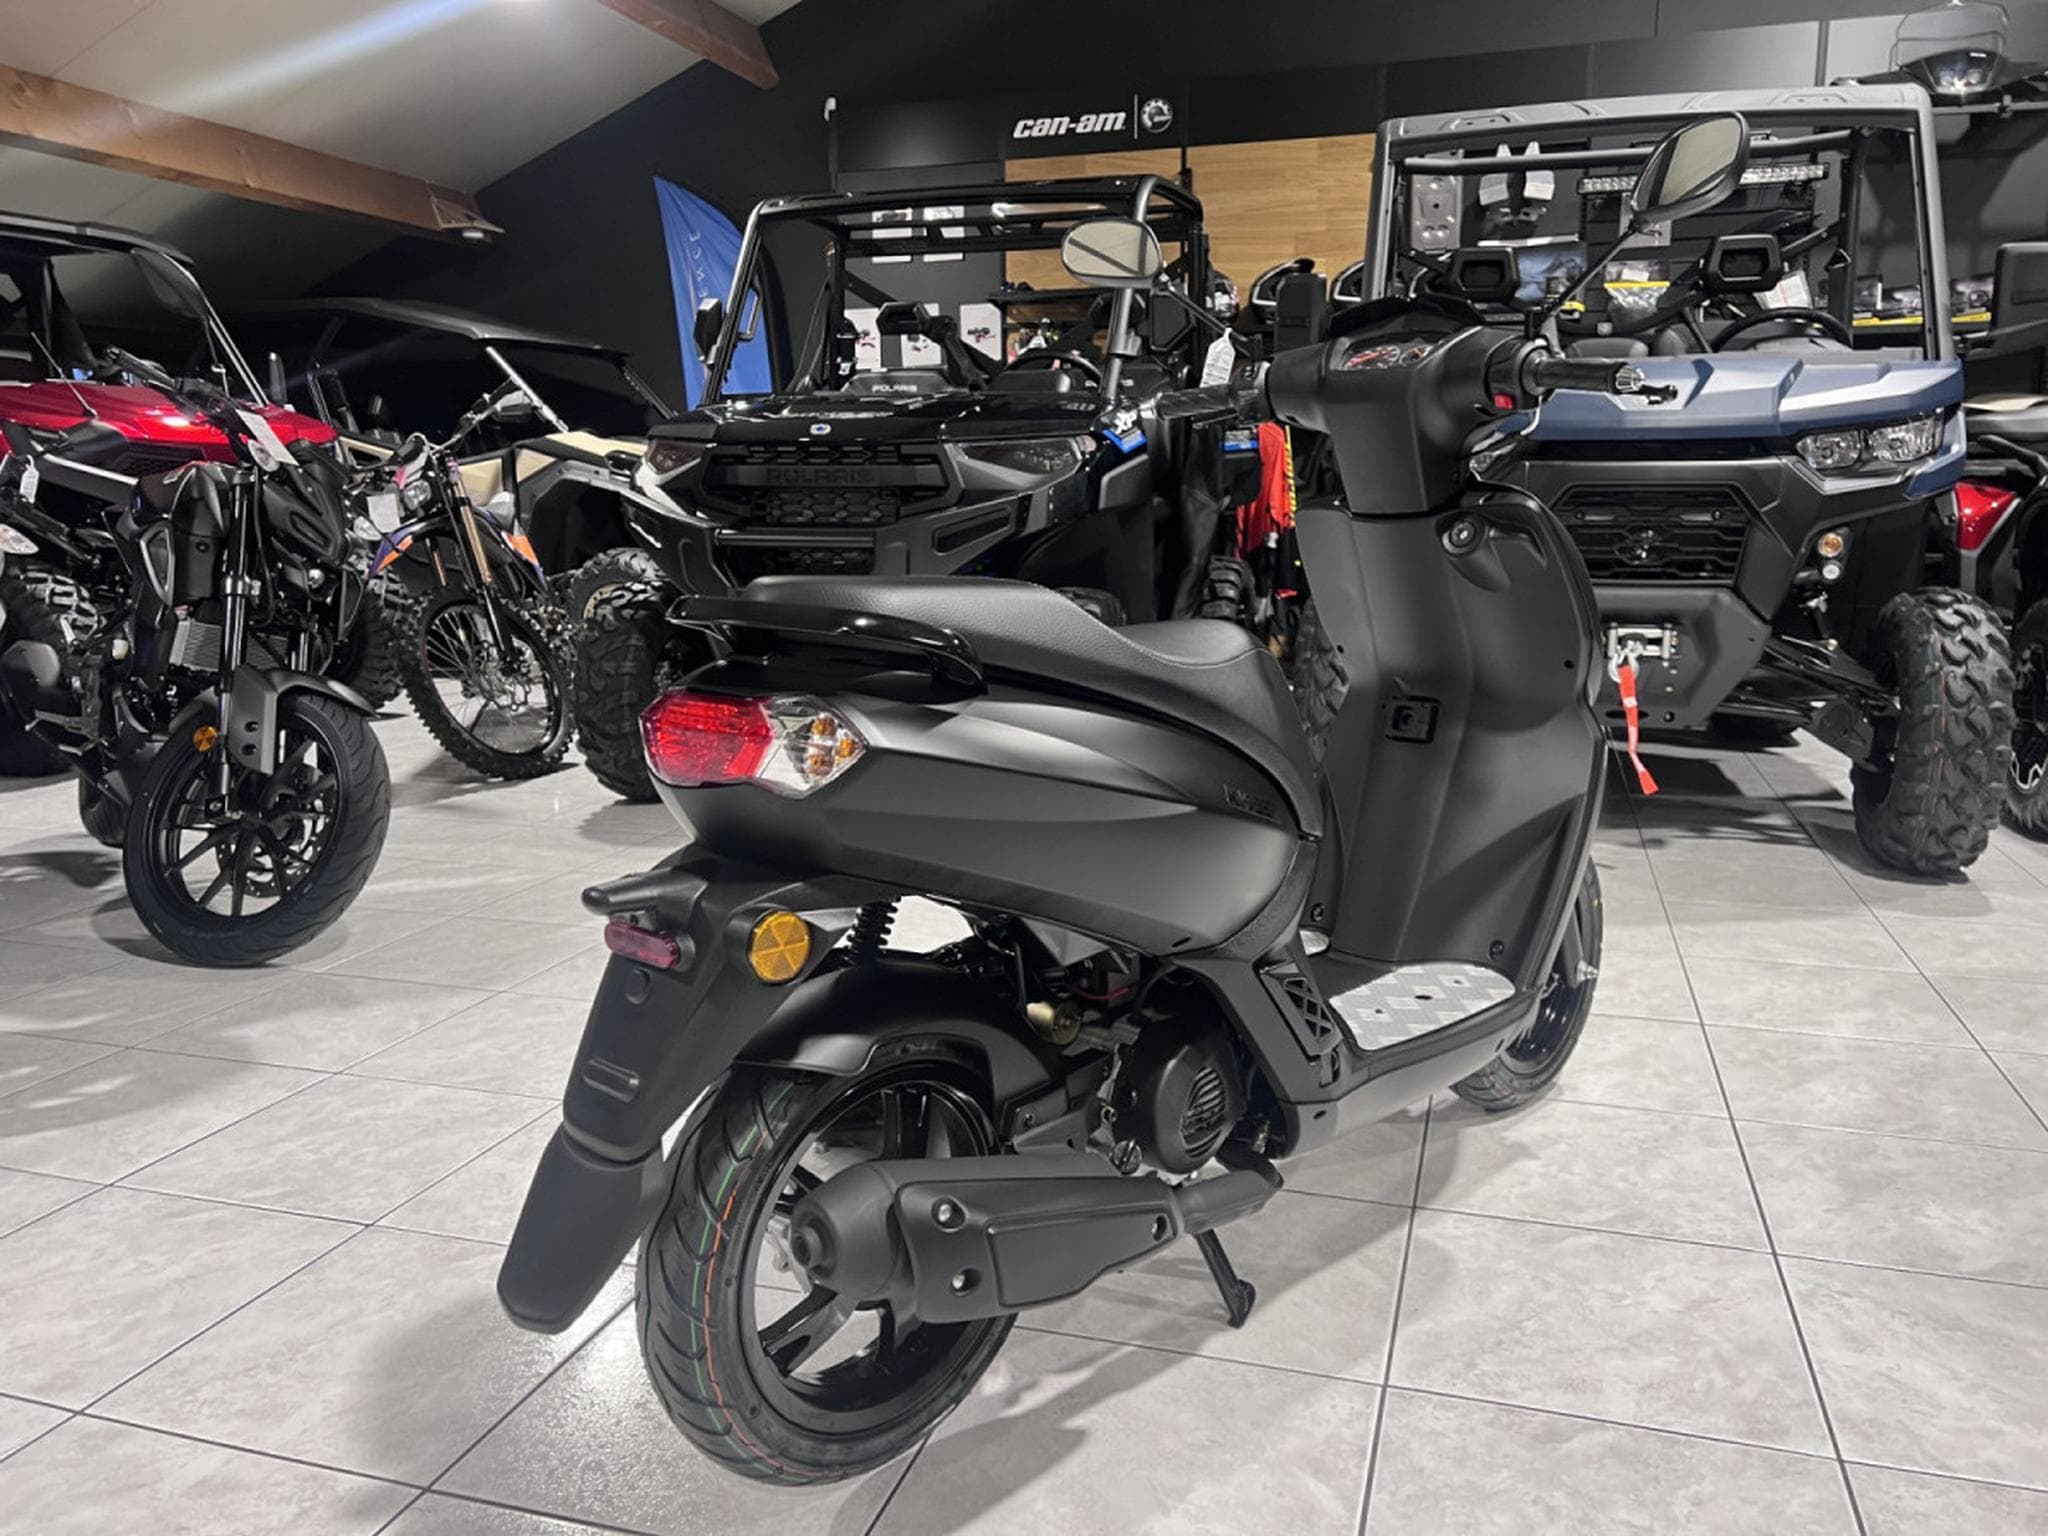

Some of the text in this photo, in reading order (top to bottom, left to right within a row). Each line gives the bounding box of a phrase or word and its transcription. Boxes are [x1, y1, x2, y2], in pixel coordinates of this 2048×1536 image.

[1012, 111, 1126, 139] can-am
[872, 384, 918, 393] POLARIS
[766, 468, 875, 485] POLARIS
